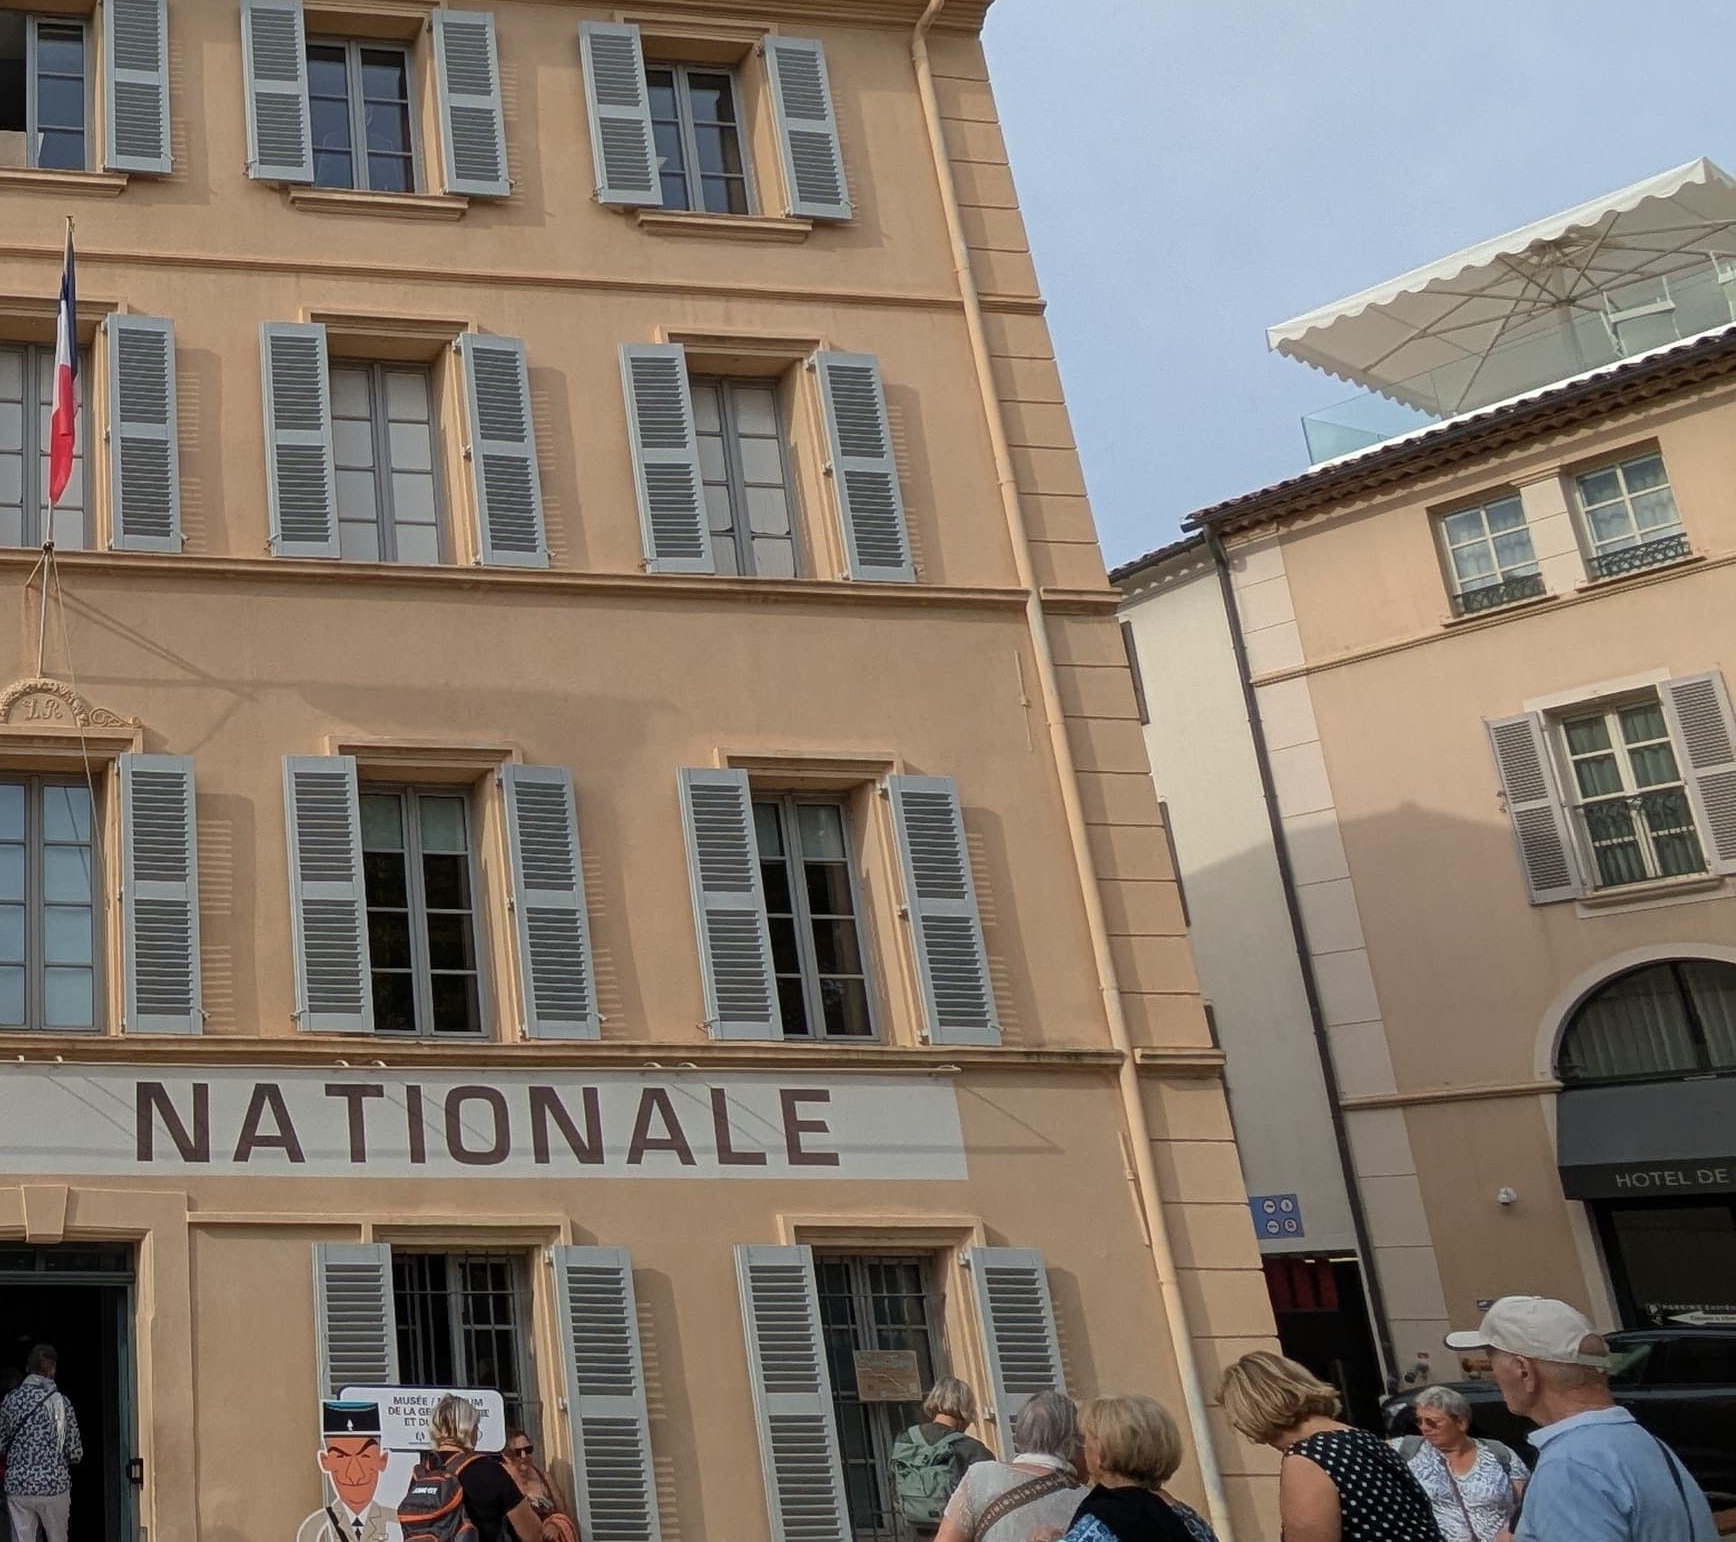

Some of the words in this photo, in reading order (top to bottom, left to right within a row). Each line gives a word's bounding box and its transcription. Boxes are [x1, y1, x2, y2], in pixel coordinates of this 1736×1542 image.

[135, 1081, 841, 1167] NATIONALE
[1615, 1170, 1692, 1188] HOTEL
[1696, 1168, 1731, 1185] DE
[393, 1396, 428, 1406] MUSÉE
[387, 1406, 402, 1416] DE
[403, 1407, 417, 1417] LA
[403, 1417, 417, 1427] ET
